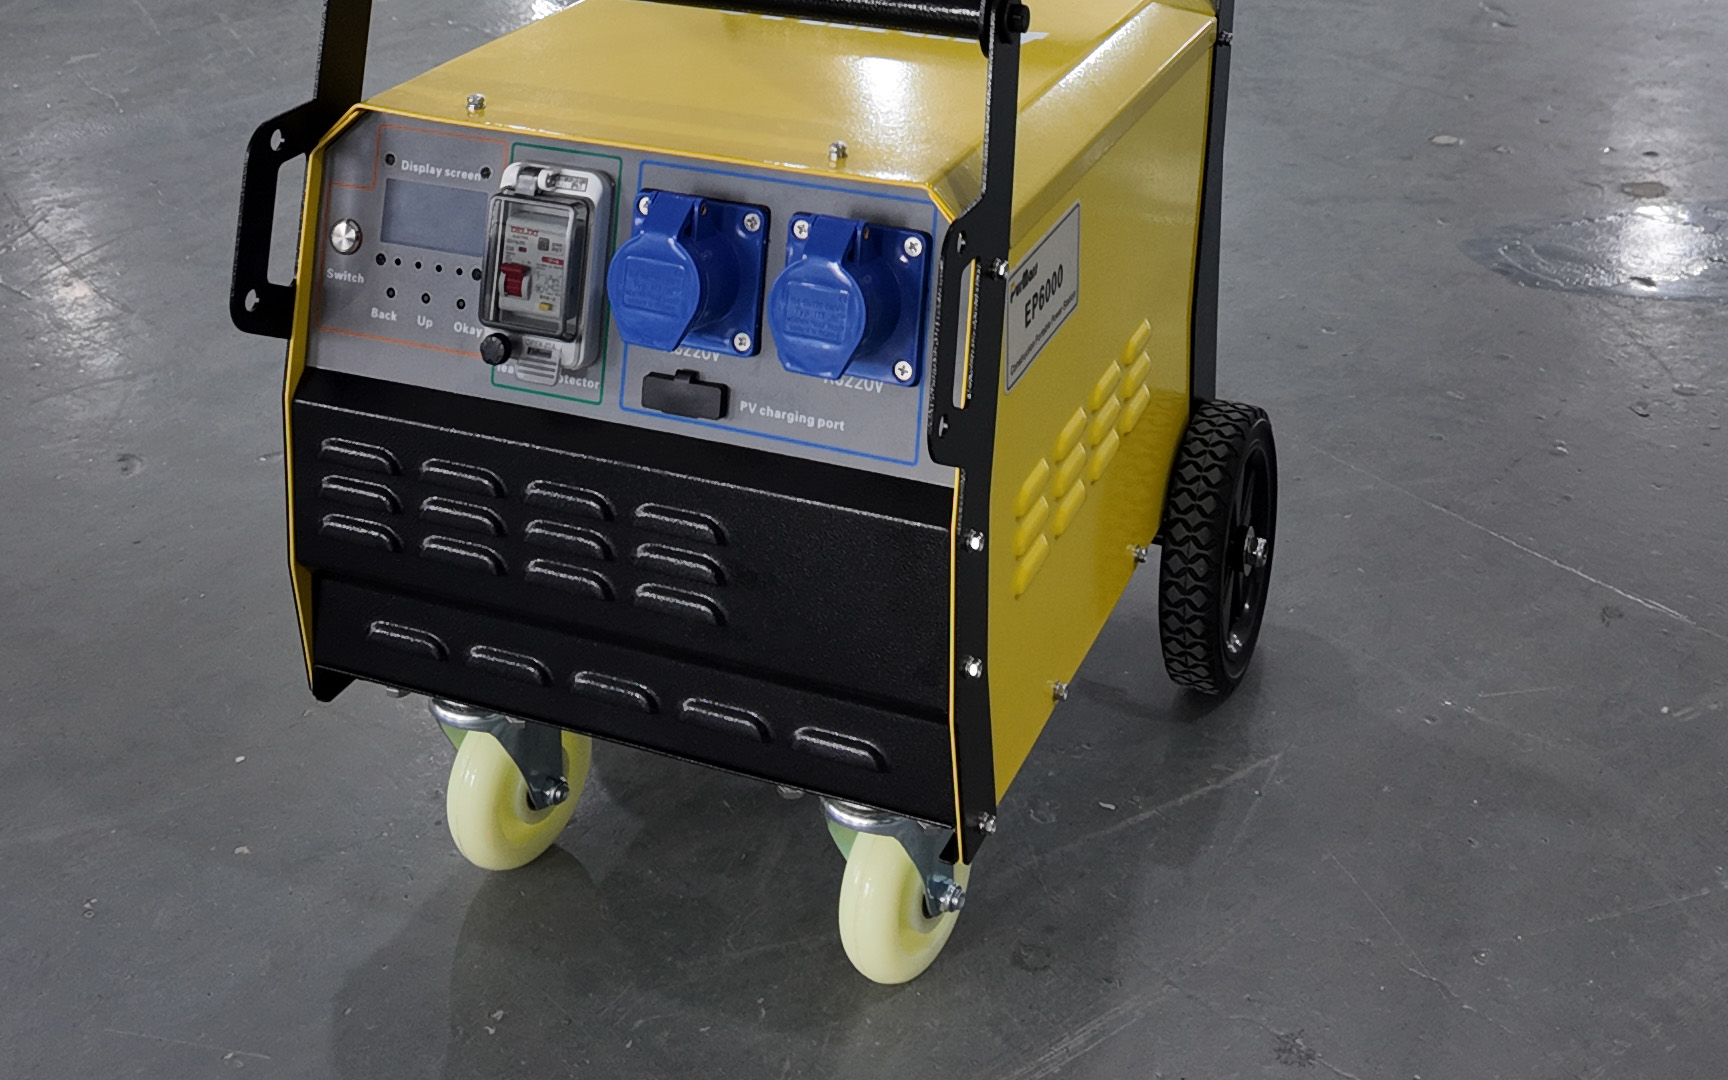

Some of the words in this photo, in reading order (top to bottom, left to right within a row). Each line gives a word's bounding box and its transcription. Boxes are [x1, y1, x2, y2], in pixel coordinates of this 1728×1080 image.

[401, 159, 442, 177] Display
[444, 168, 481, 182] screen
[327, 268, 364, 284] Switch
[1025, 263, 1063, 328] EP6000
[371, 308, 397, 322] Back
[417, 316, 433, 329] Up
[454, 321, 483, 338] Okay
[671, 346, 720, 362] 220V
[558, 374, 600, 390] otector
[740, 400, 758, 414] PV
[759, 405, 815, 428] charging
[817, 418, 845, 432] port
